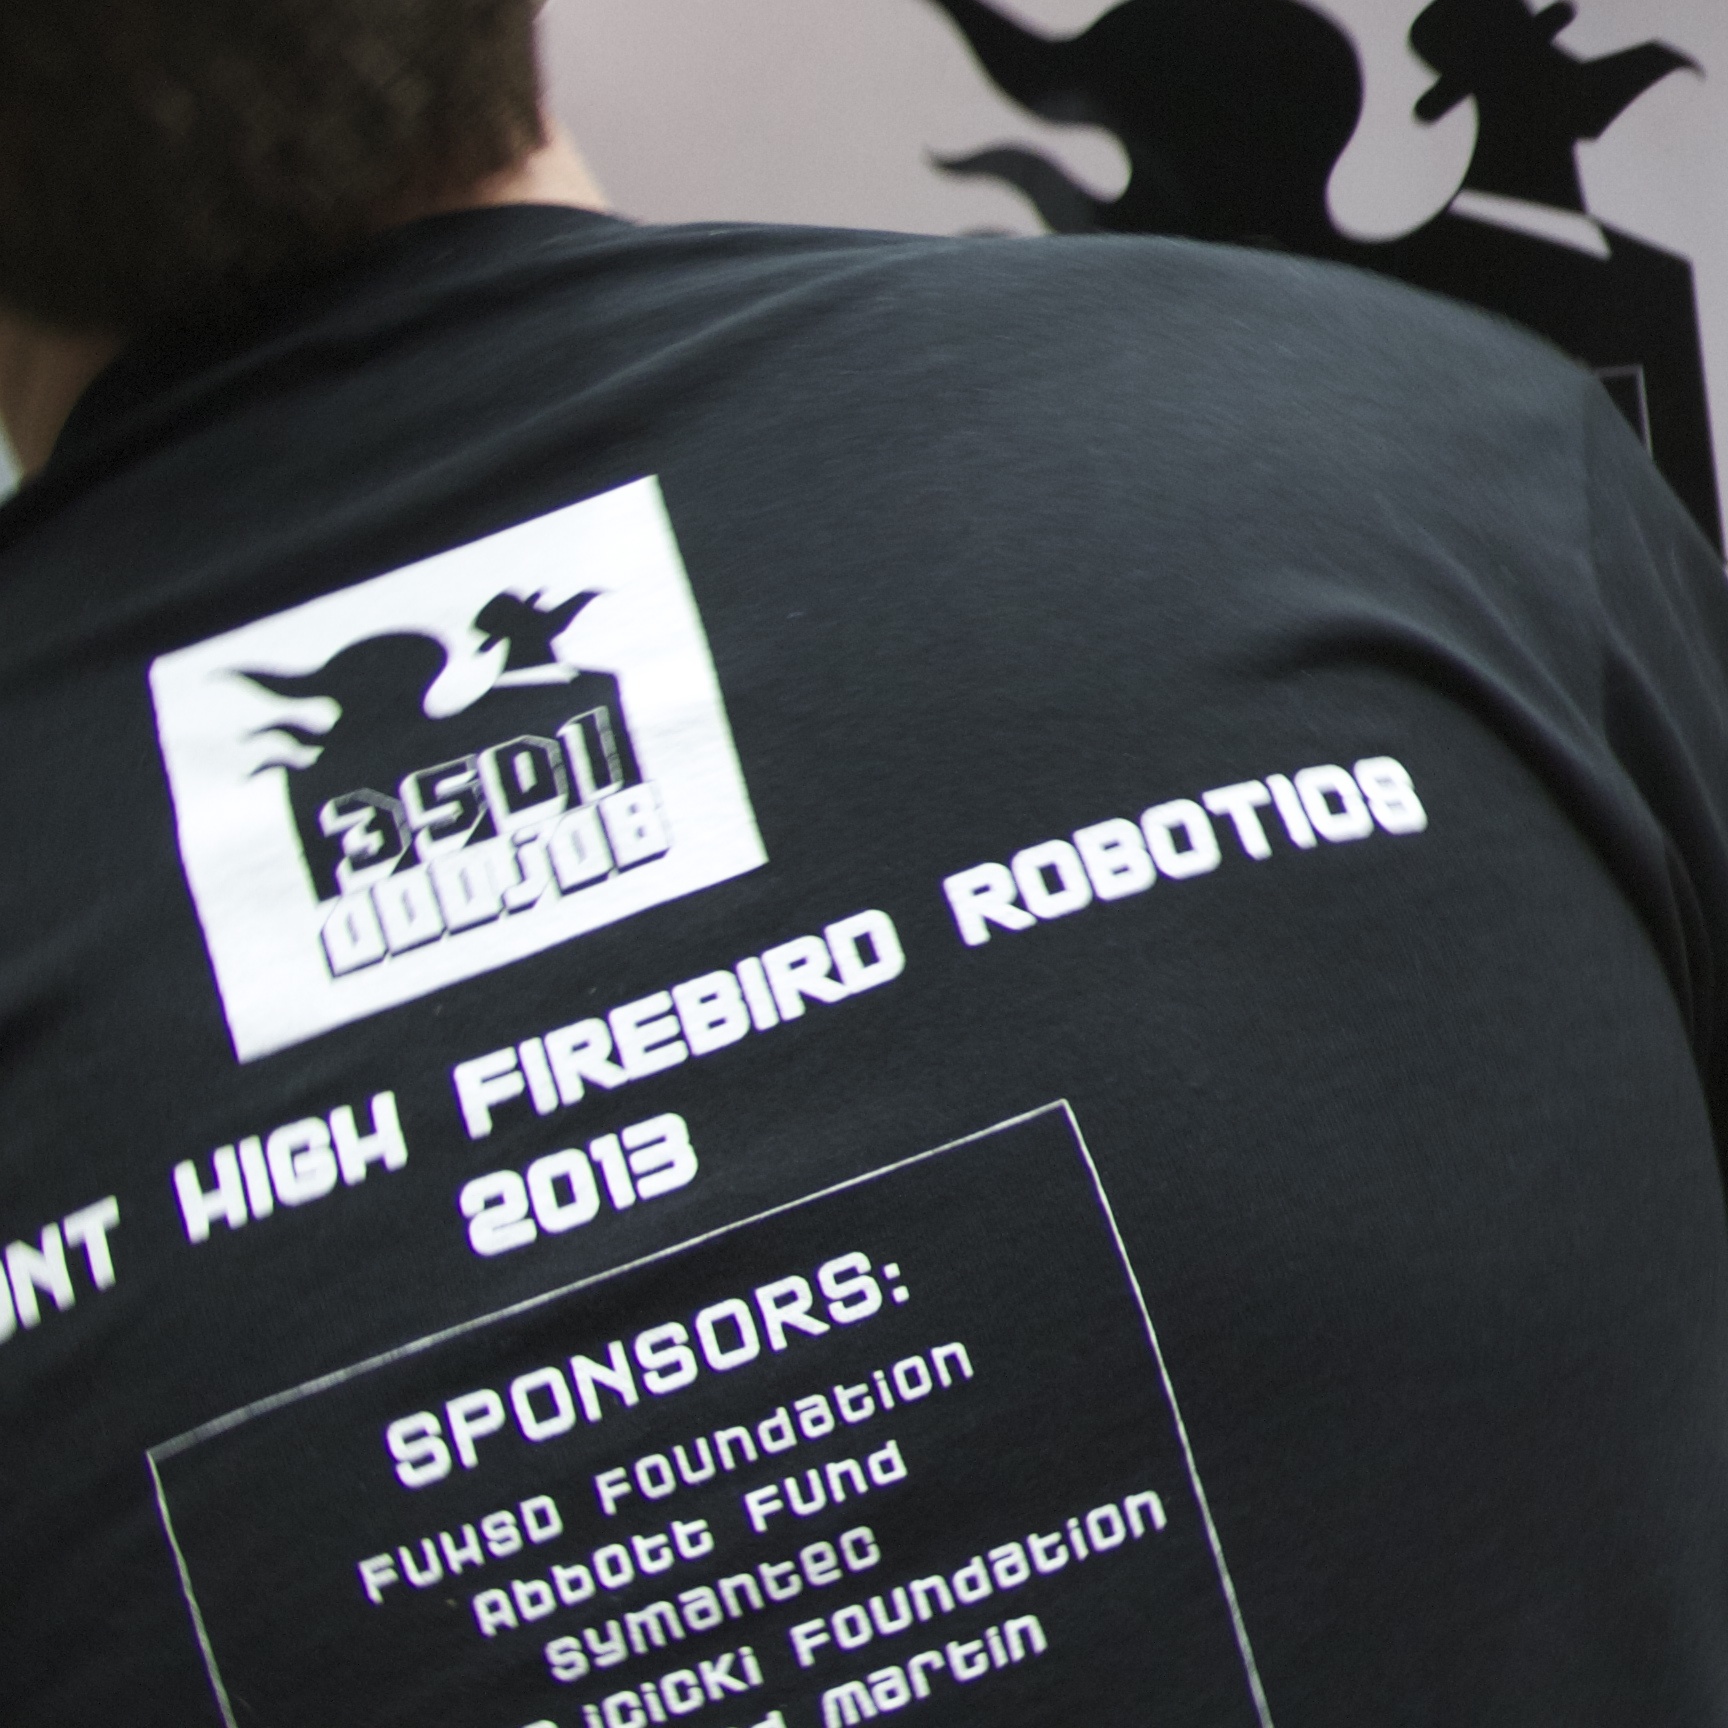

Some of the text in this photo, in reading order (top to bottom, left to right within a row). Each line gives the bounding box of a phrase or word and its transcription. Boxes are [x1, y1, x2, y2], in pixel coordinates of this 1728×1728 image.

[174, 1091, 409, 1243] HIGH
[454, 909, 906, 1138] FIREBIRD
[459, 1112, 698, 1256] 2013
[387, 1252, 909, 1488] SPONSORS:
[596, 1342, 974, 1514] Foundation
[473, 1440, 908, 1635] Abbott Fund
[790, 1491, 1167, 1666] Foundation
